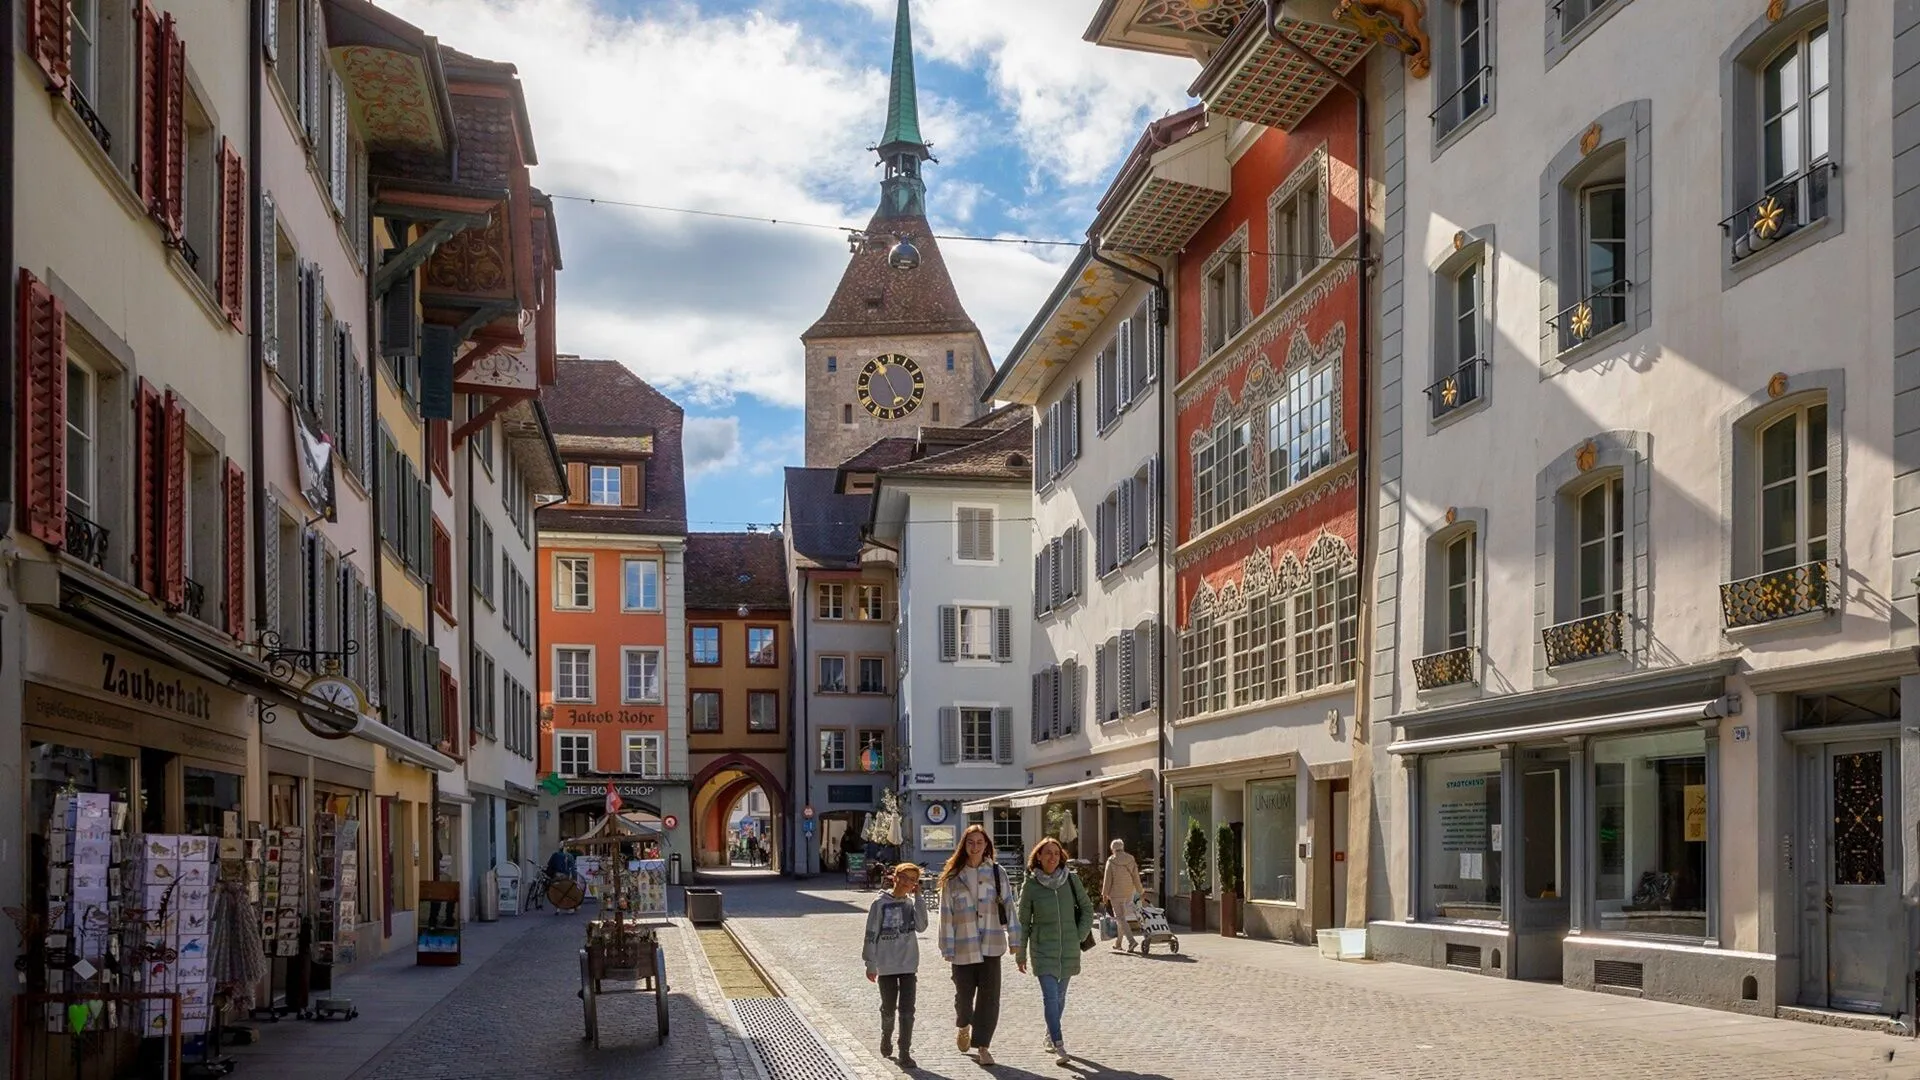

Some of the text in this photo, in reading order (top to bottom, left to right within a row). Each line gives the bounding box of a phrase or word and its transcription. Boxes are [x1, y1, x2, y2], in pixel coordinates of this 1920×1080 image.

[102, 653, 211, 720] Zauberhaft
[568, 709, 655, 725] Jakob Rohr
[1735, 729, 1746, 740] 20
[566, 786, 655, 796] THE BOY SHOP
[1255, 792, 1291, 811] UNIKUM
